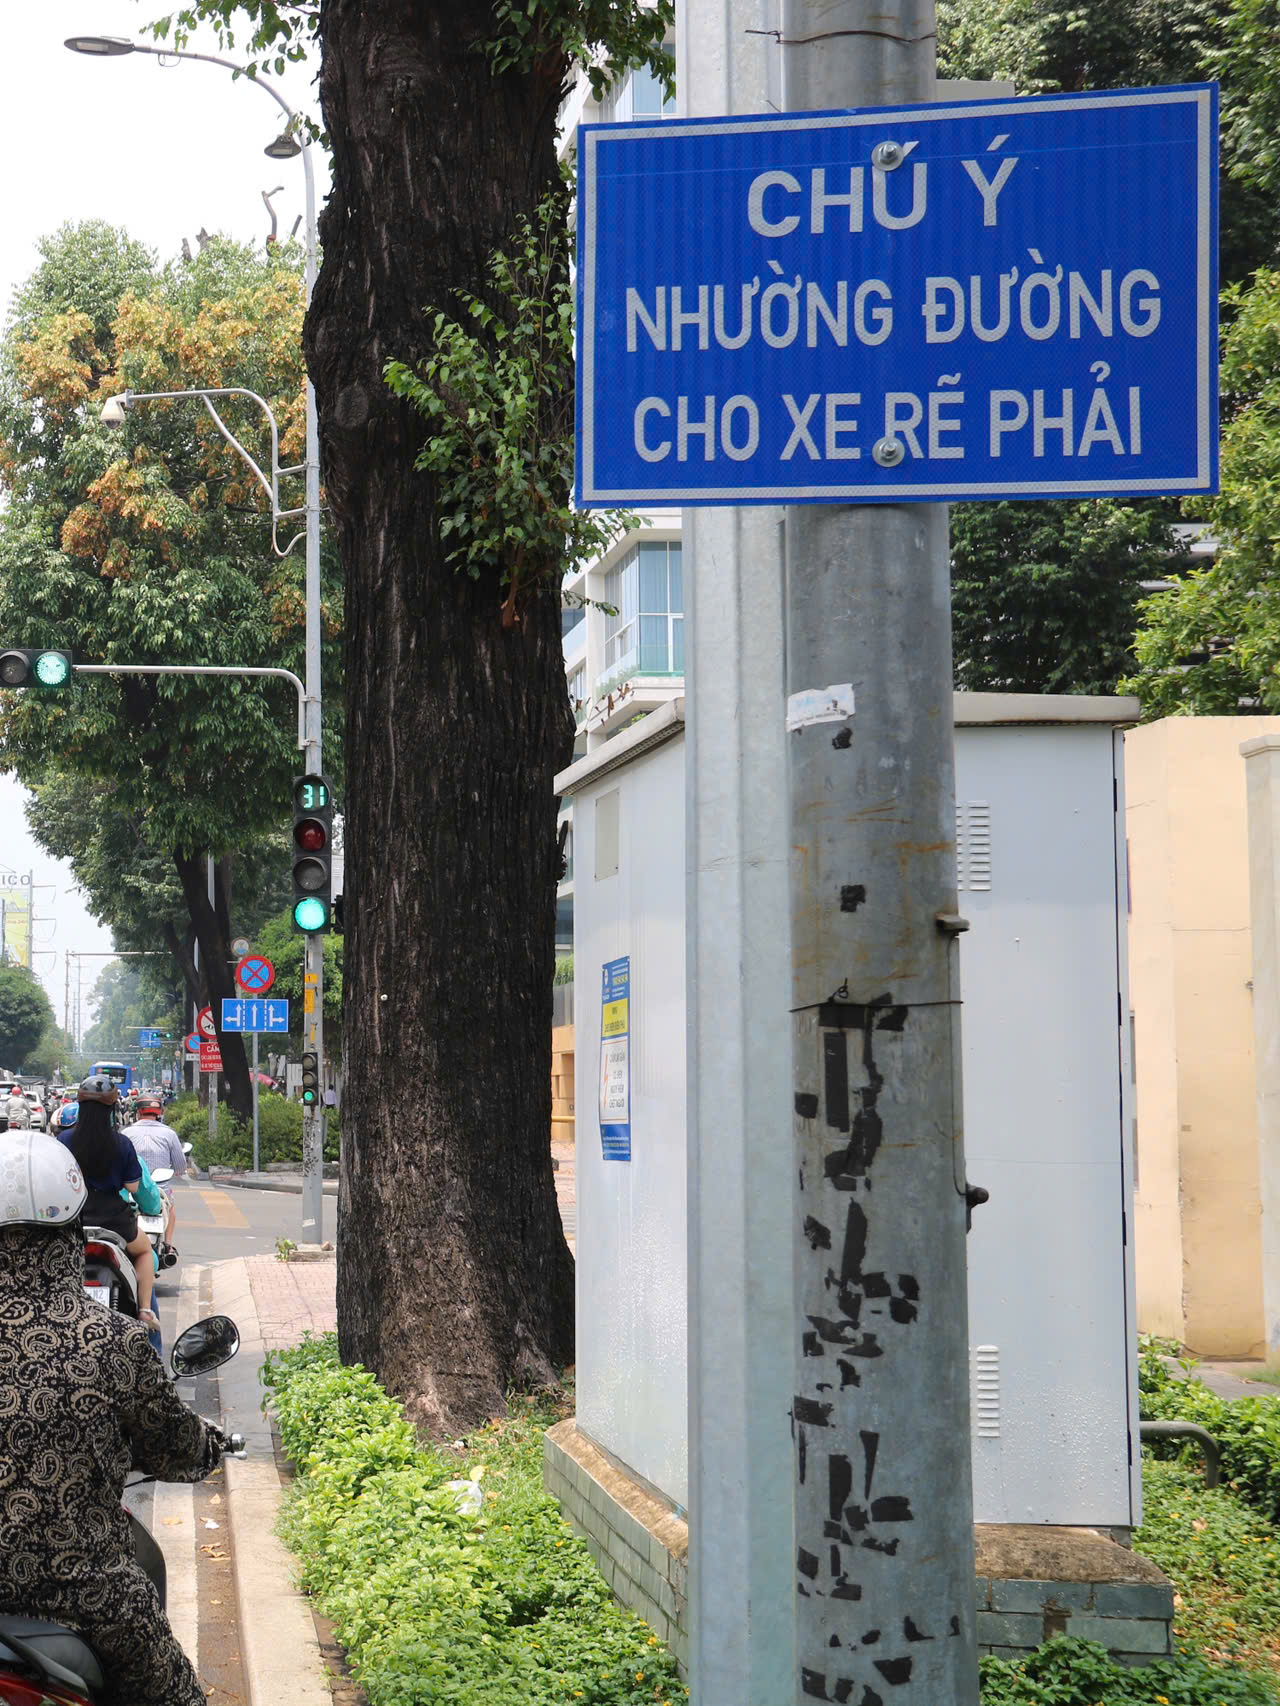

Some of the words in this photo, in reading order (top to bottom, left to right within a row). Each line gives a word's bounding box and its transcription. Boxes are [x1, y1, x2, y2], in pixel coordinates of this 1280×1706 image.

[747, 140, 928, 238] CHÚ
[962, 134, 1019, 227] Ý
[625, 259, 894, 353] NHƯỜNG
[922, 247, 1162, 344] ĐƯỜNG
[633, 394, 760, 463] CHO
[780, 392, 862, 461] XE
[883, 371, 966, 460] RẼ
[988, 360, 1142, 458] PHẢI
[303, 784, 325, 808] 31
